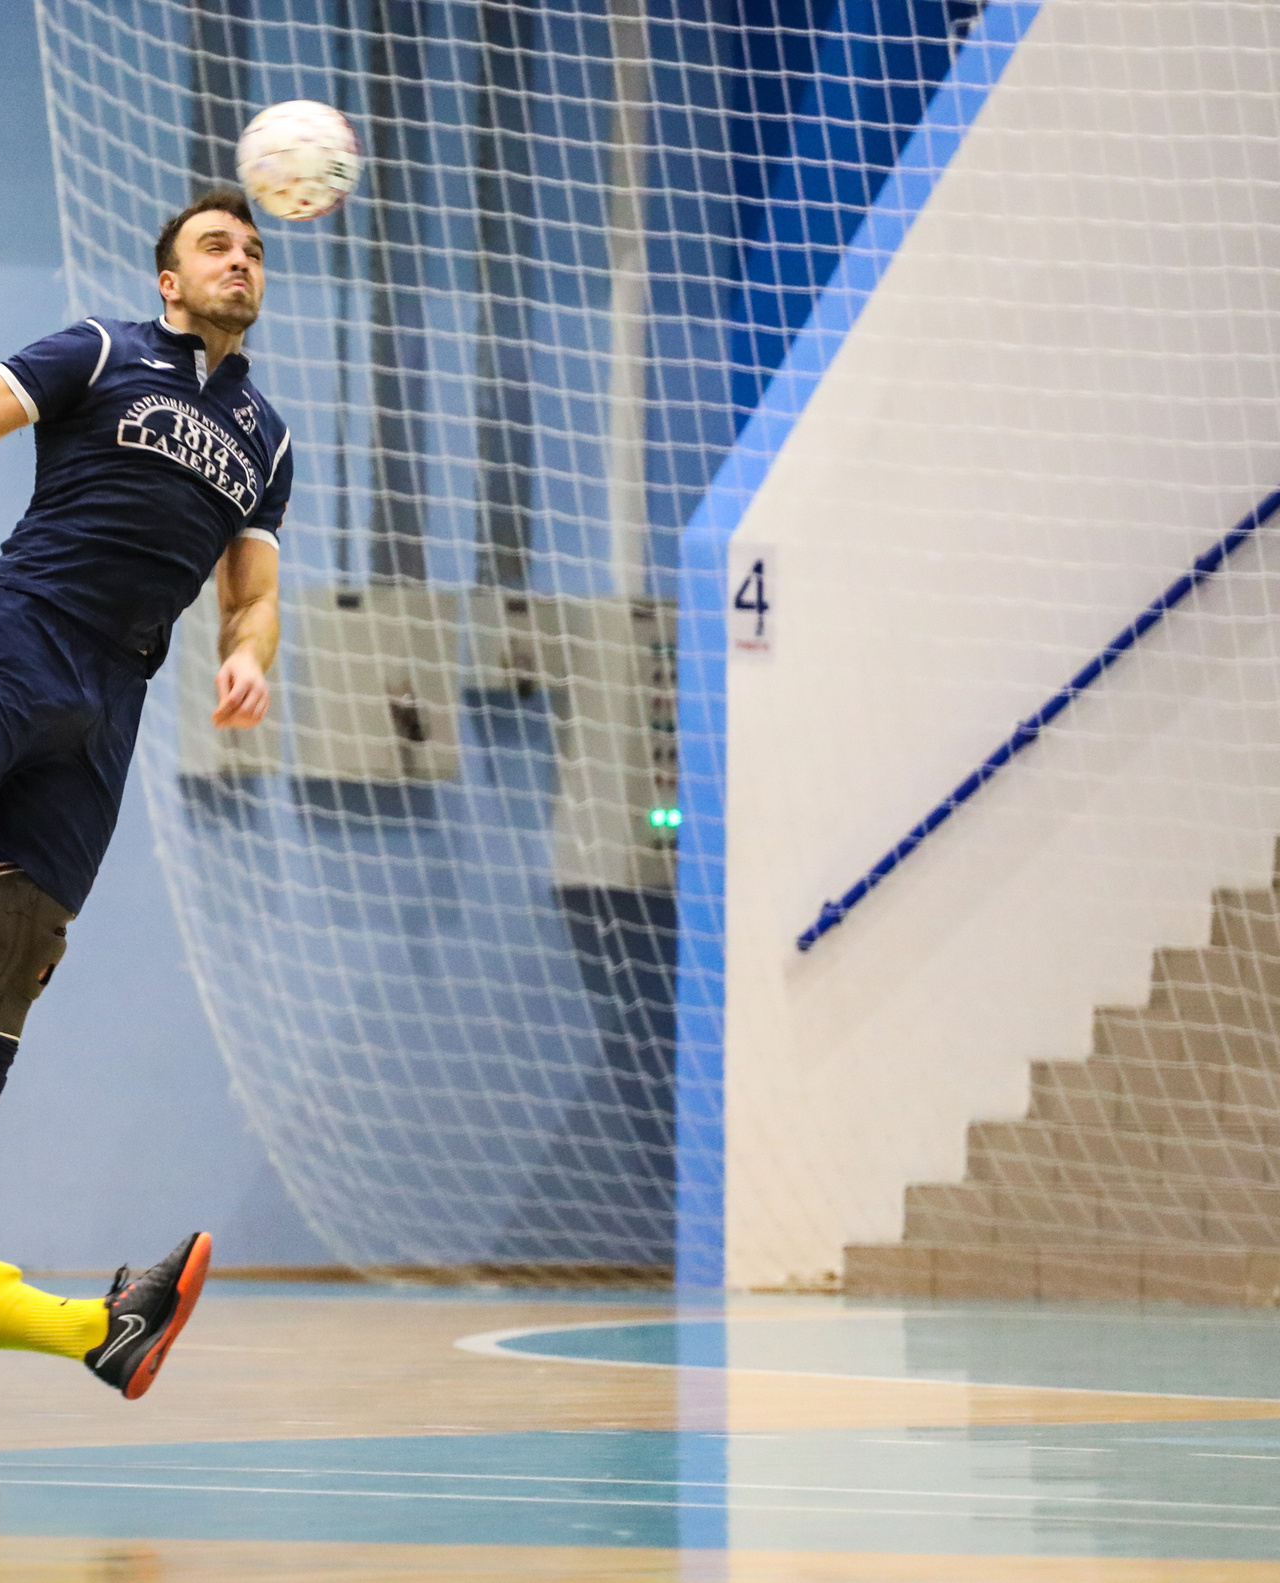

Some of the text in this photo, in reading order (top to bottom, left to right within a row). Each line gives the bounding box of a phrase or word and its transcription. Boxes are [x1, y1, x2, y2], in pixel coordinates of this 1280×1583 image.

[139, 426, 247, 502] ГАЛЕРЕЯ
[170, 413, 230, 471] 1814
[734, 559, 769, 636] 4
